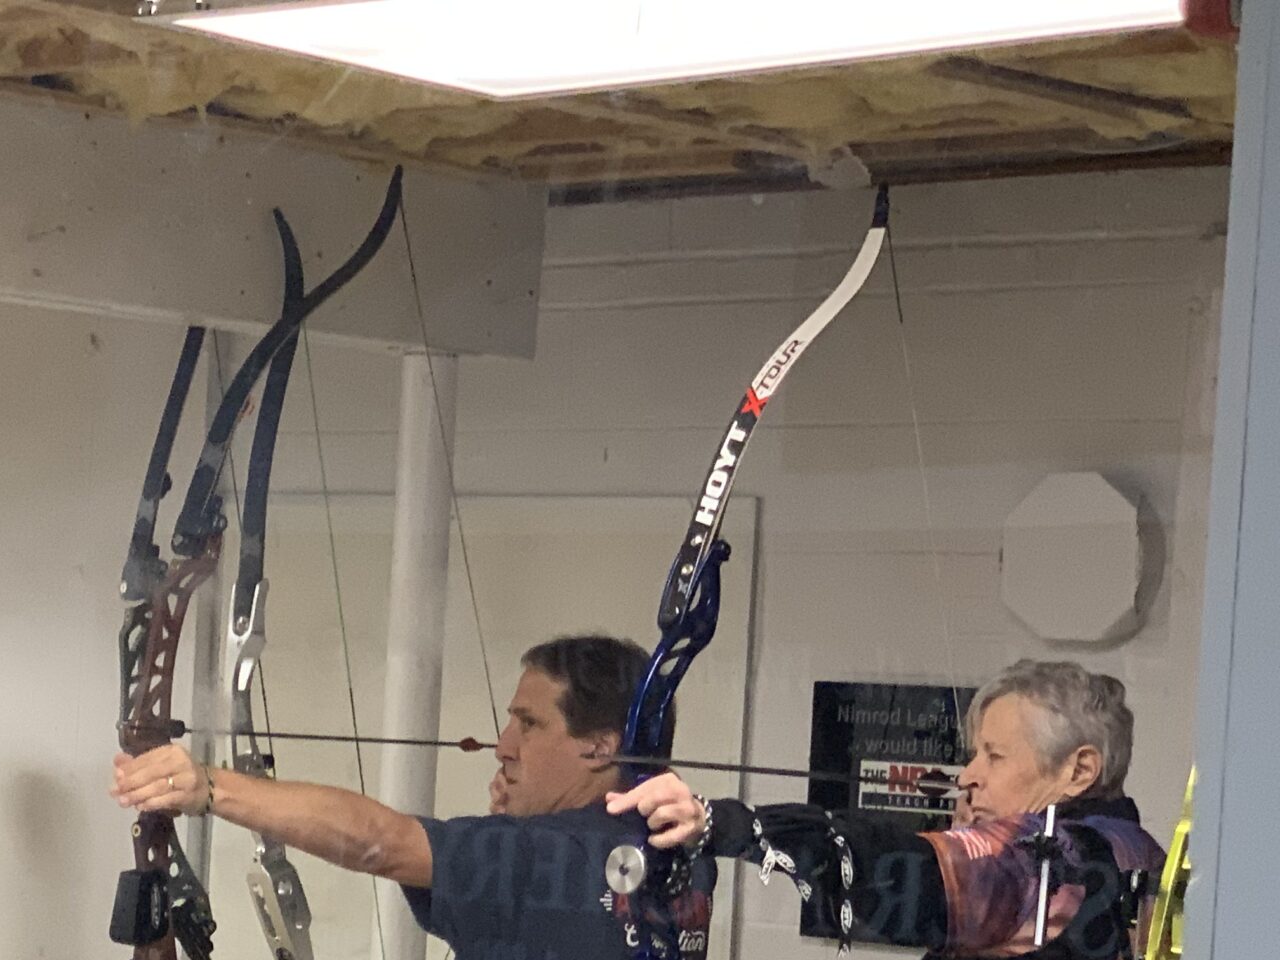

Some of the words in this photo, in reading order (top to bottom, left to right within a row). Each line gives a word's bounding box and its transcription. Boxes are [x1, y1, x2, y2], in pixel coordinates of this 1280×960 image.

[695, 420, 746, 526] HOYT
[838, 704, 901, 727] Nimrod
[864, 737, 917, 756] would
[923, 737, 954, 759] like
[888, 765, 942, 793] NR
[888, 796, 929, 808] TEACH
